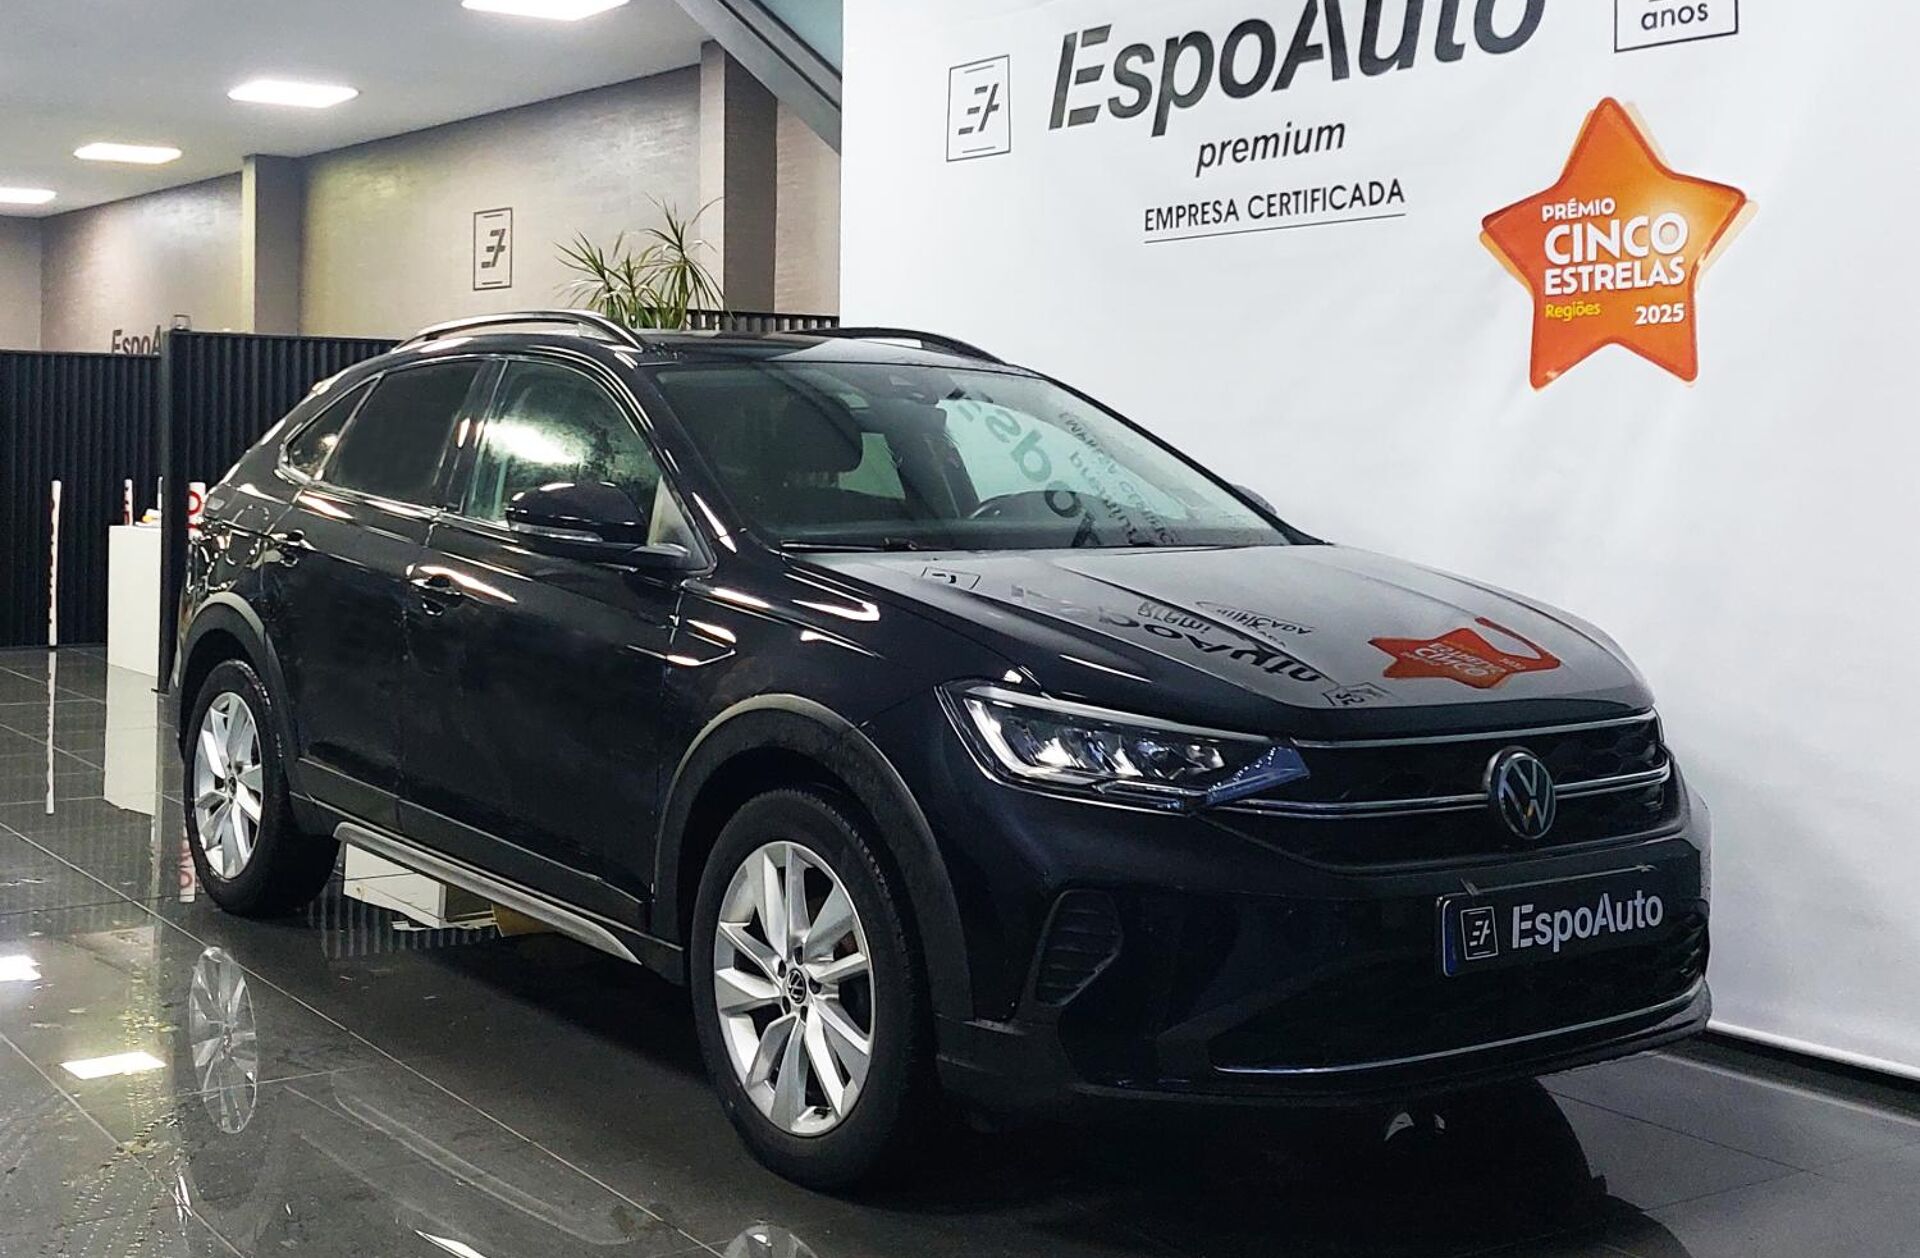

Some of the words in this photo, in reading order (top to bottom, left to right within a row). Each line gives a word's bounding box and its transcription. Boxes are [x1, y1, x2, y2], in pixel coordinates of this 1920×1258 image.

[1641, 2, 1709, 31] anos
[1048, 0, 1544, 137] EspoAuto
[1195, 122, 1346, 178] premium
[1144, 198, 1240, 232] EMPRESA
[1247, 178, 1406, 221] CERTIFICADA
[1541, 197, 1616, 222] PRÉMIO
[1544, 212, 1689, 266] CINCO
[1544, 256, 1686, 296] ESTRELAS
[1545, 301, 1602, 322] Regiões
[1635, 303, 1685, 326] 2025
[1512, 890, 1664, 952] EspoAuto
